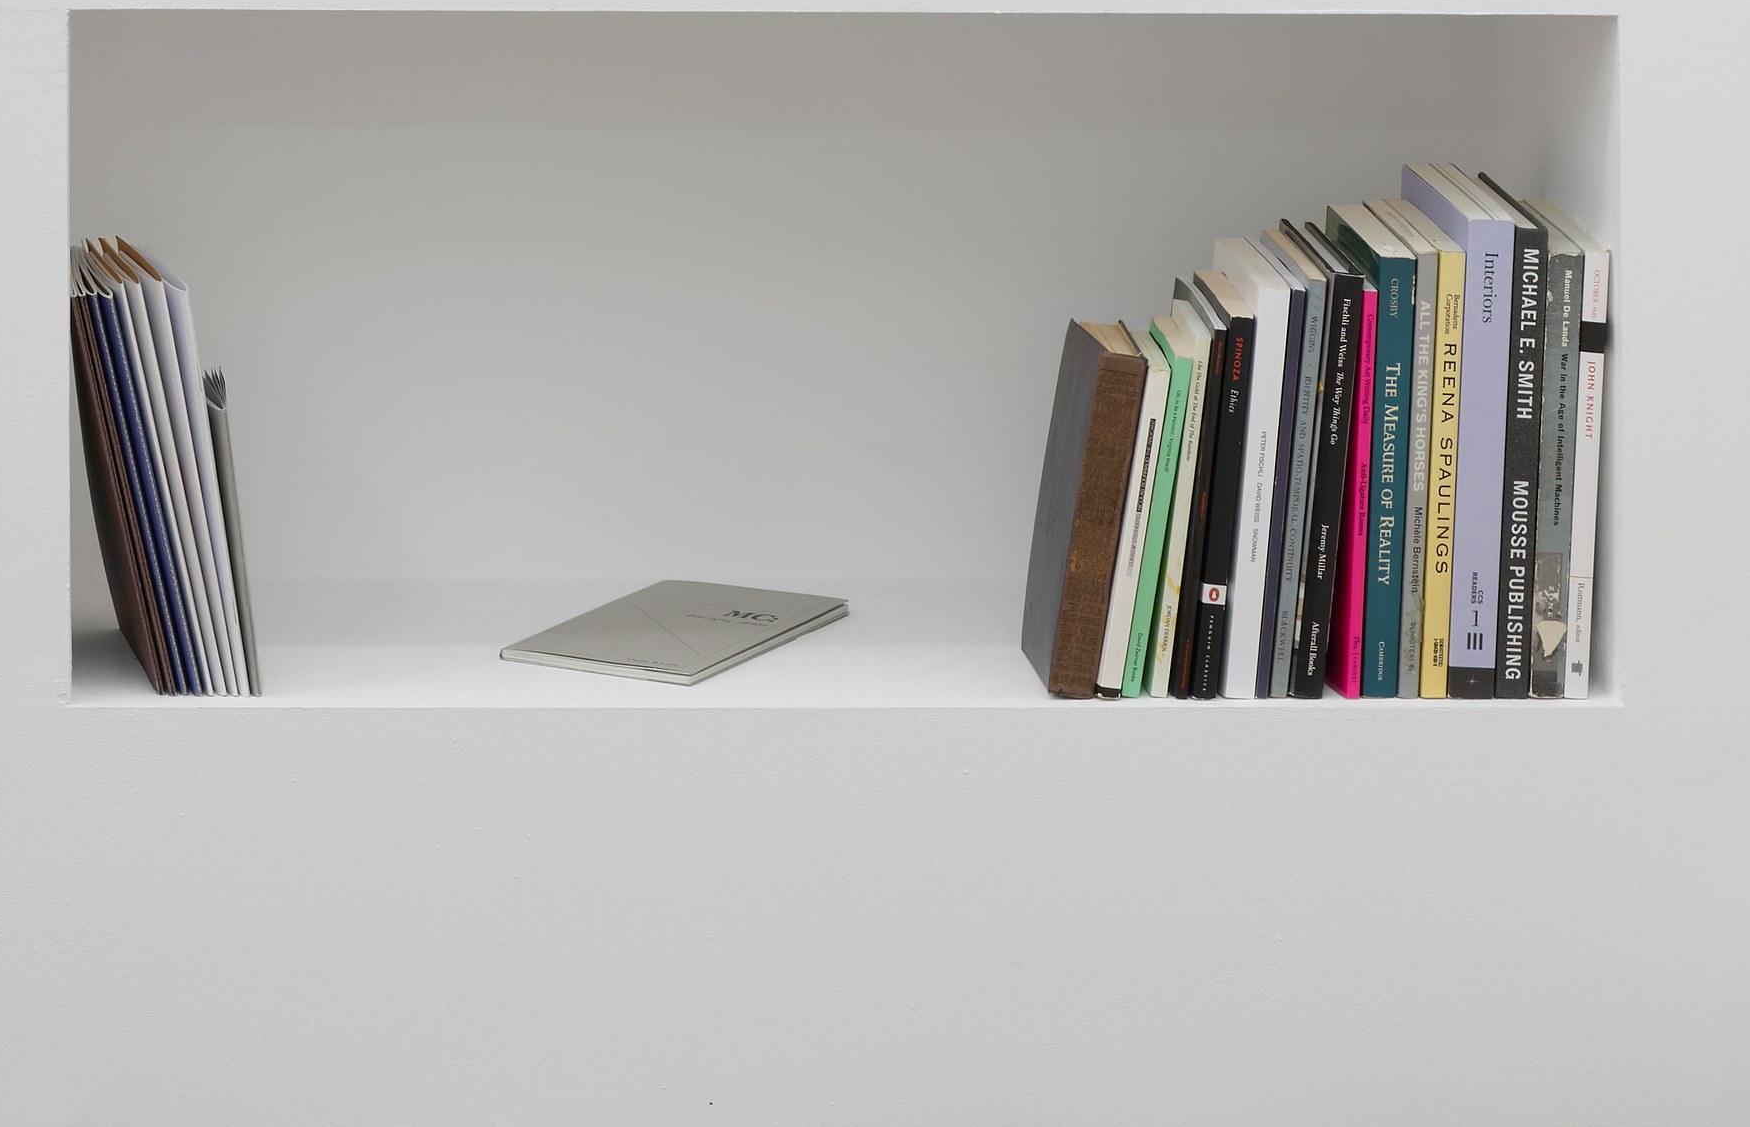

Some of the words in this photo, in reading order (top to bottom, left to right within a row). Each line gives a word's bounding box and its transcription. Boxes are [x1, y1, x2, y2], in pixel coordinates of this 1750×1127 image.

[1390, 278, 1399, 318] CROSBY
[1482, 252, 1499, 323] Interiors
[1520, 248, 1540, 330] MICHAEL
[1564, 270, 1572, 302] Manuel
[1342, 298, 1351, 325] Fischli
[1419, 300, 1431, 329] ALL
[1444, 294, 1453, 334] Corporation
[1453, 294, 1461, 329] Bernadette
[1563, 305, 1571, 317] De
[1308, 316, 1318, 353] WIGGINS
[1340, 327, 1348, 342] and
[1418, 334, 1430, 364] THE
[1519, 338, 1535, 353] E.
[1562, 321, 1570, 347] Landa
[1232, 337, 1243, 381] SPINOZA
[1338, 344, 1347, 367] Weiss
[1336, 372, 1344, 385] The
[1385, 362, 1401, 397] THE
[1441, 343, 1457, 423] REENA
[1517, 360, 1535, 419] SMITH
[1560, 374, 1568, 382] in
[1587, 361, 1596, 390] JOHN
[1229, 389, 1240, 413] Ethics
[1301, 376, 1312, 416] IDENTITY
[1332, 387, 1343, 405] Way
[1415, 370, 1429, 422] KING'S
[1557, 403, 1566, 420] Age
[1299, 420, 1307, 439] AND
[1330, 407, 1341, 432] Things
[1558, 423, 1565, 432] of
[1585, 396, 1594, 439] KNIGHT
[1330, 434, 1338, 445] Go
[1381, 404, 1399, 483] MEASURE
[1413, 426, 1426, 491] HORSES
[1554, 436, 1565, 480] Intelligent
[1290, 443, 1305, 523] SPATIO-TEMPORAL
[1381, 489, 1395, 509] OF
[1436, 438, 1453, 574] SPAULINGS
[1510, 481, 1529, 559] MOUSSE
[1554, 484, 1562, 526] Machines
[1319, 524, 1329, 552] Jeremy
[1414, 507, 1423, 543] Michèle
[1286, 528, 1297, 582] CONTINUITY
[1317, 554, 1326, 579] Millar
[1378, 515, 1395, 585] REALITY
[1411, 546, 1421, 593] Bernstein
[1277, 611, 1289, 663] BLACKWELL
[1310, 622, 1320, 651] Afterall
[1505, 566, 1525, 679] PUBLISHING
[1202, 655, 1210, 692] CLASSICS
[1308, 653, 1316, 676] Books
